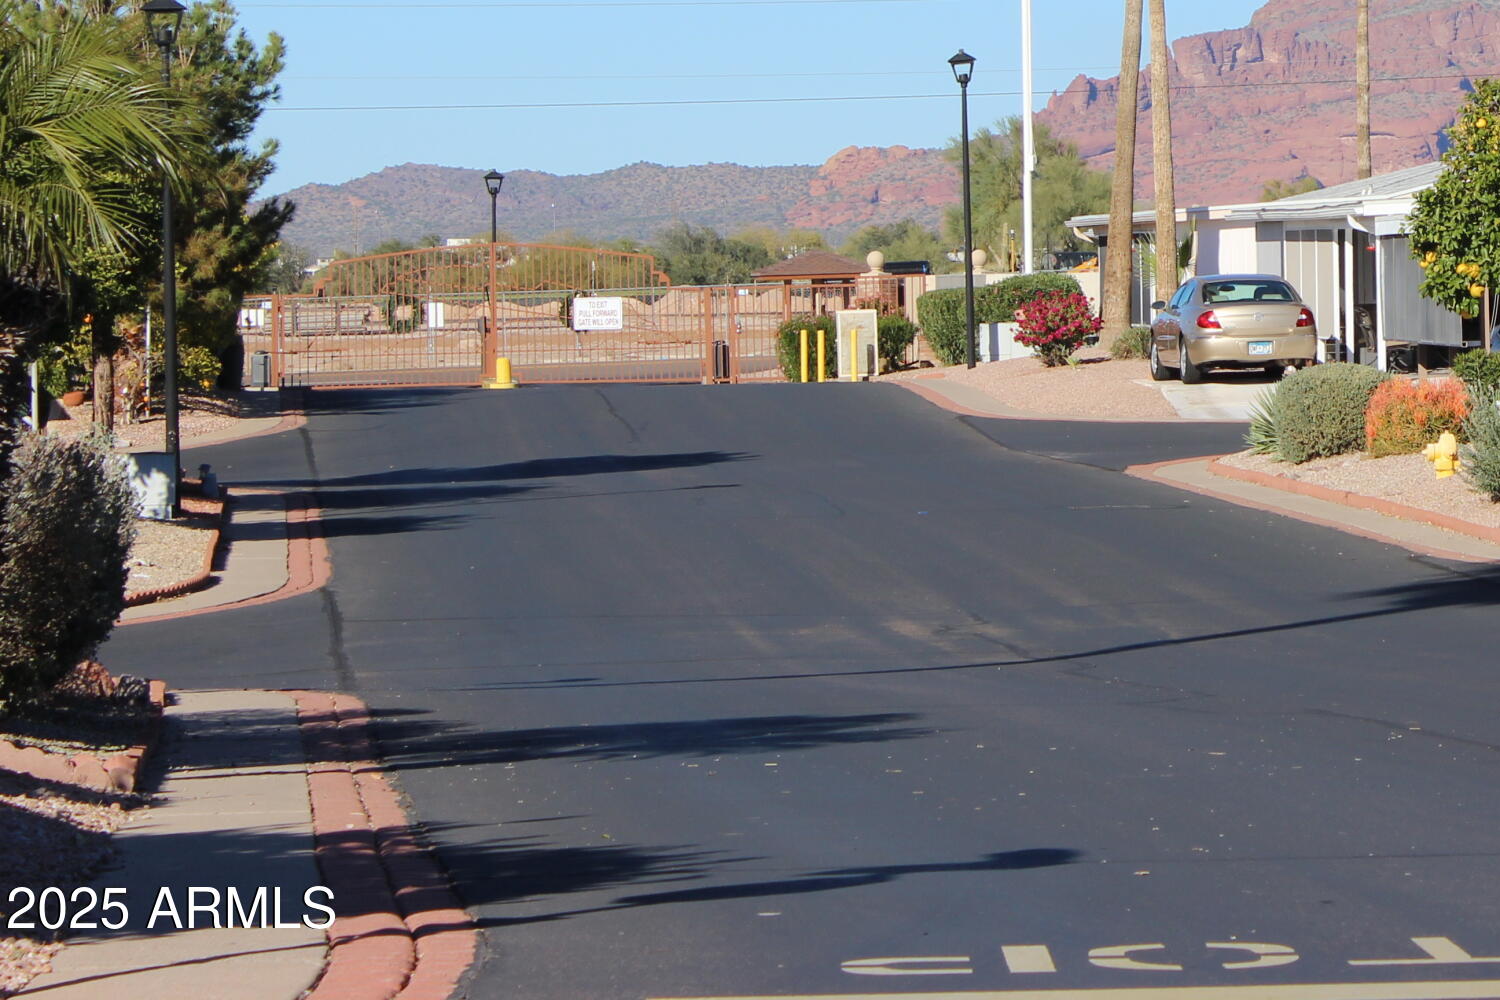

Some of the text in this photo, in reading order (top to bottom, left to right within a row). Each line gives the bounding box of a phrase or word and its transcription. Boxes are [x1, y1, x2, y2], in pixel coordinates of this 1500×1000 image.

[593, 309, 617, 317] FORWARD
[578, 318, 619, 326] GATE WILL OPEN
